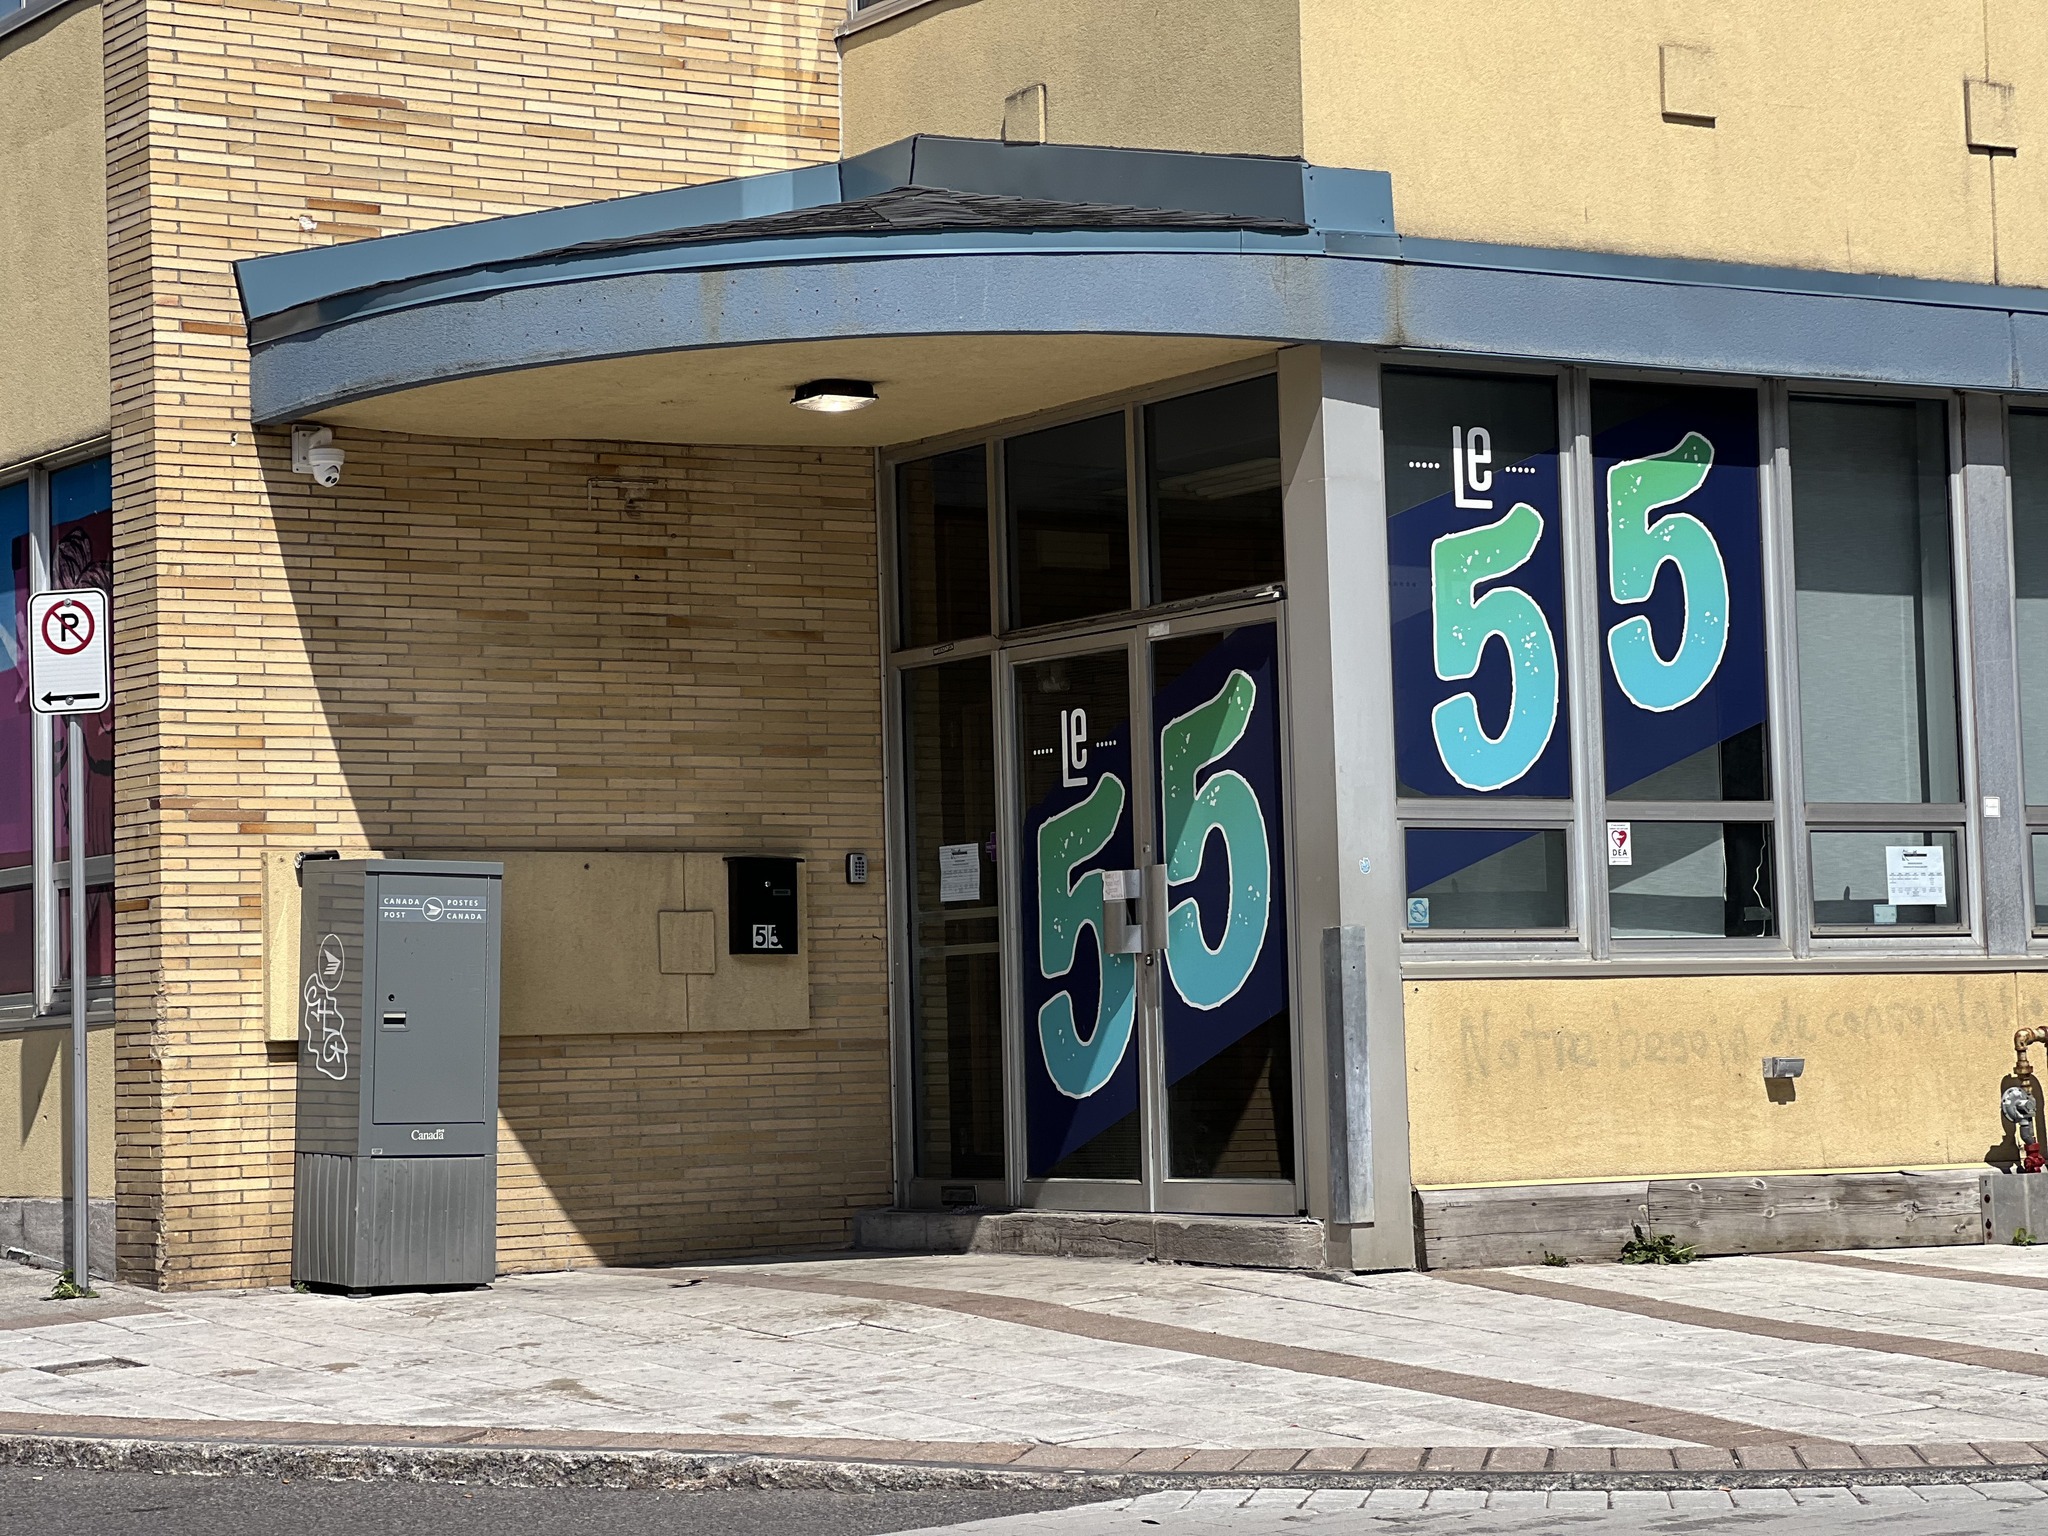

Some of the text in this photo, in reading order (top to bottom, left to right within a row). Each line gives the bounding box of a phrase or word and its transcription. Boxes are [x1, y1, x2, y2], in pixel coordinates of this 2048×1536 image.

[60, 612, 79, 642] P
[1612, 848, 1627, 856] DEA
[383, 897, 420, 906] CANADA
[447, 899, 479, 907] POSTES
[383, 911, 406, 919] POST
[446, 912, 482, 920] CANADA
[411, 1129, 445, 1141] Canada
